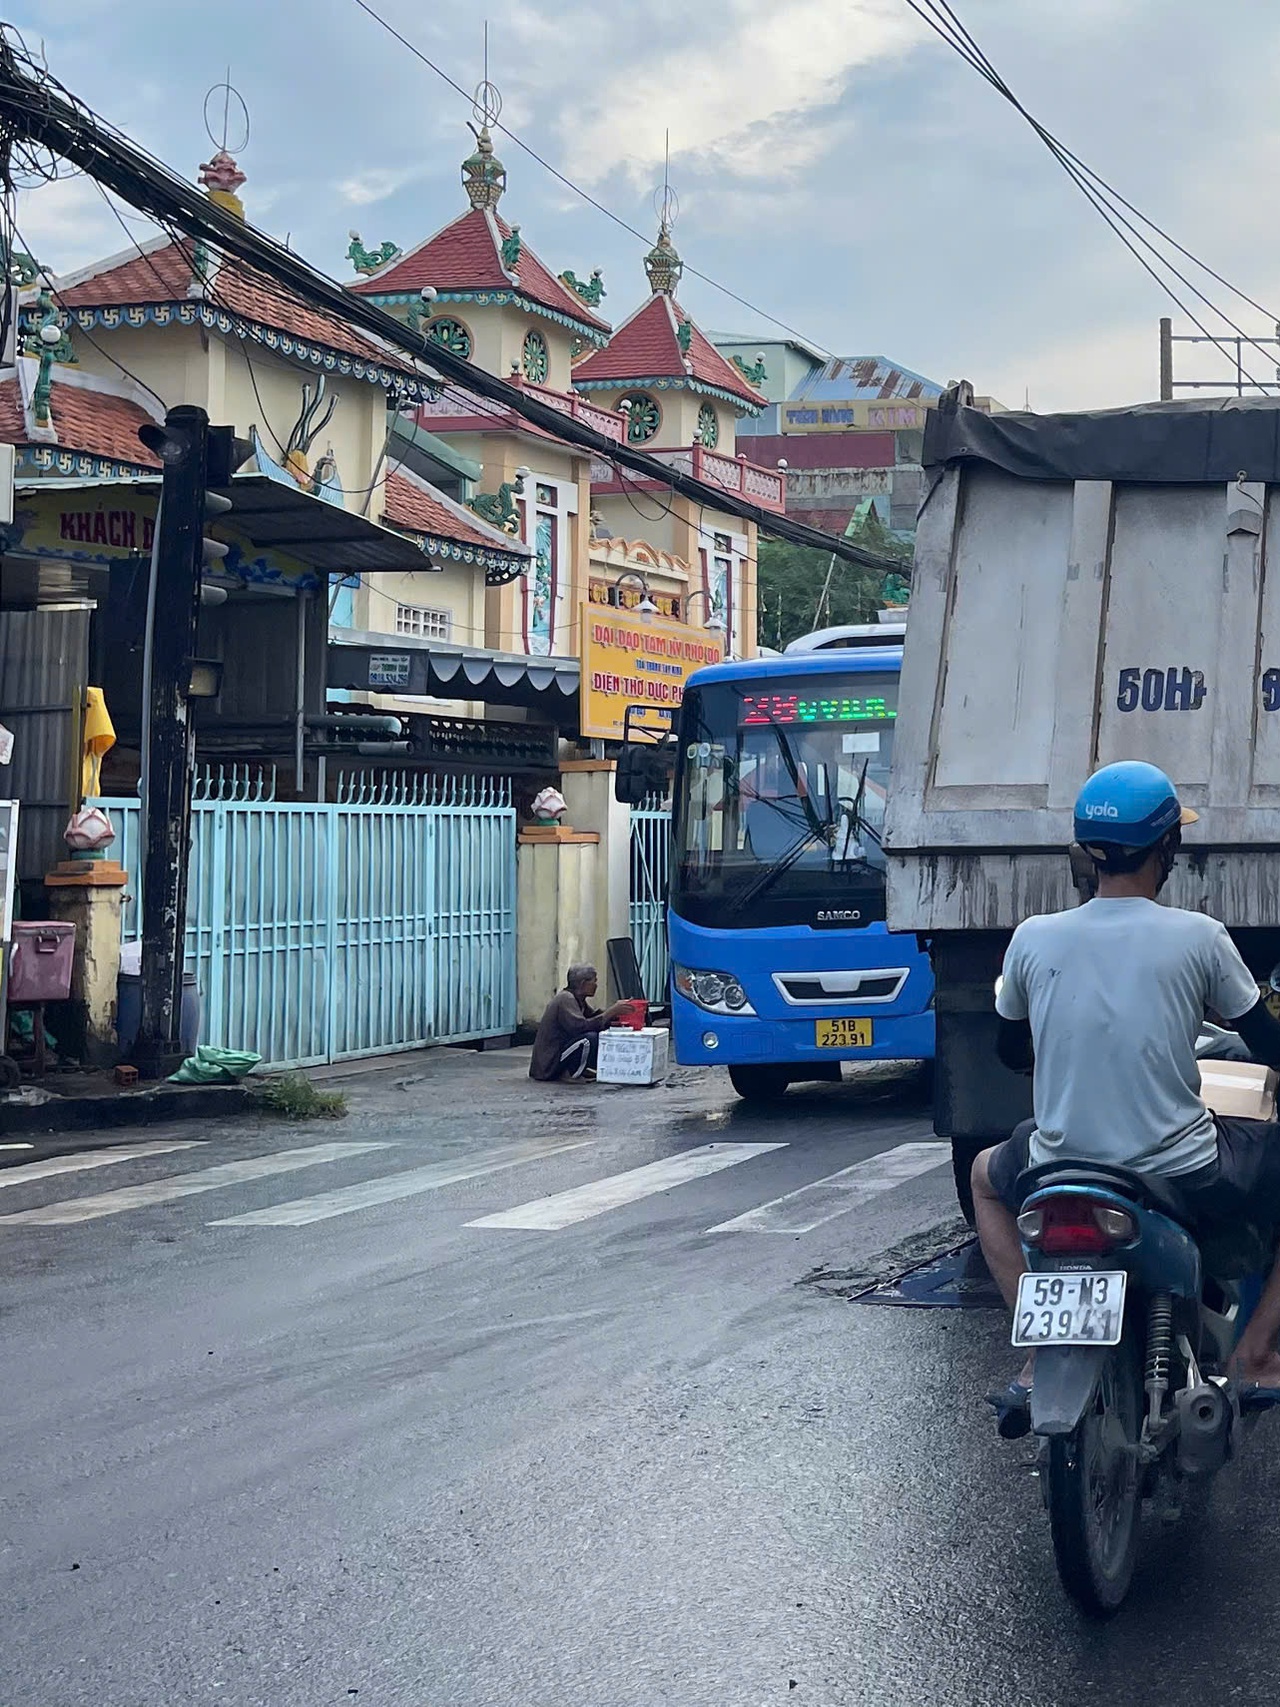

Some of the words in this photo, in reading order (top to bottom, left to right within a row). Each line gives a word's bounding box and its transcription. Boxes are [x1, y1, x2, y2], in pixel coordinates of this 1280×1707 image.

[868, 407, 916, 426] KIM
[816, 910, 860, 921] SAMCO
[832, 1020, 856, 1033] 51B
[1034, 1277, 1108, 1306] 59-N3
